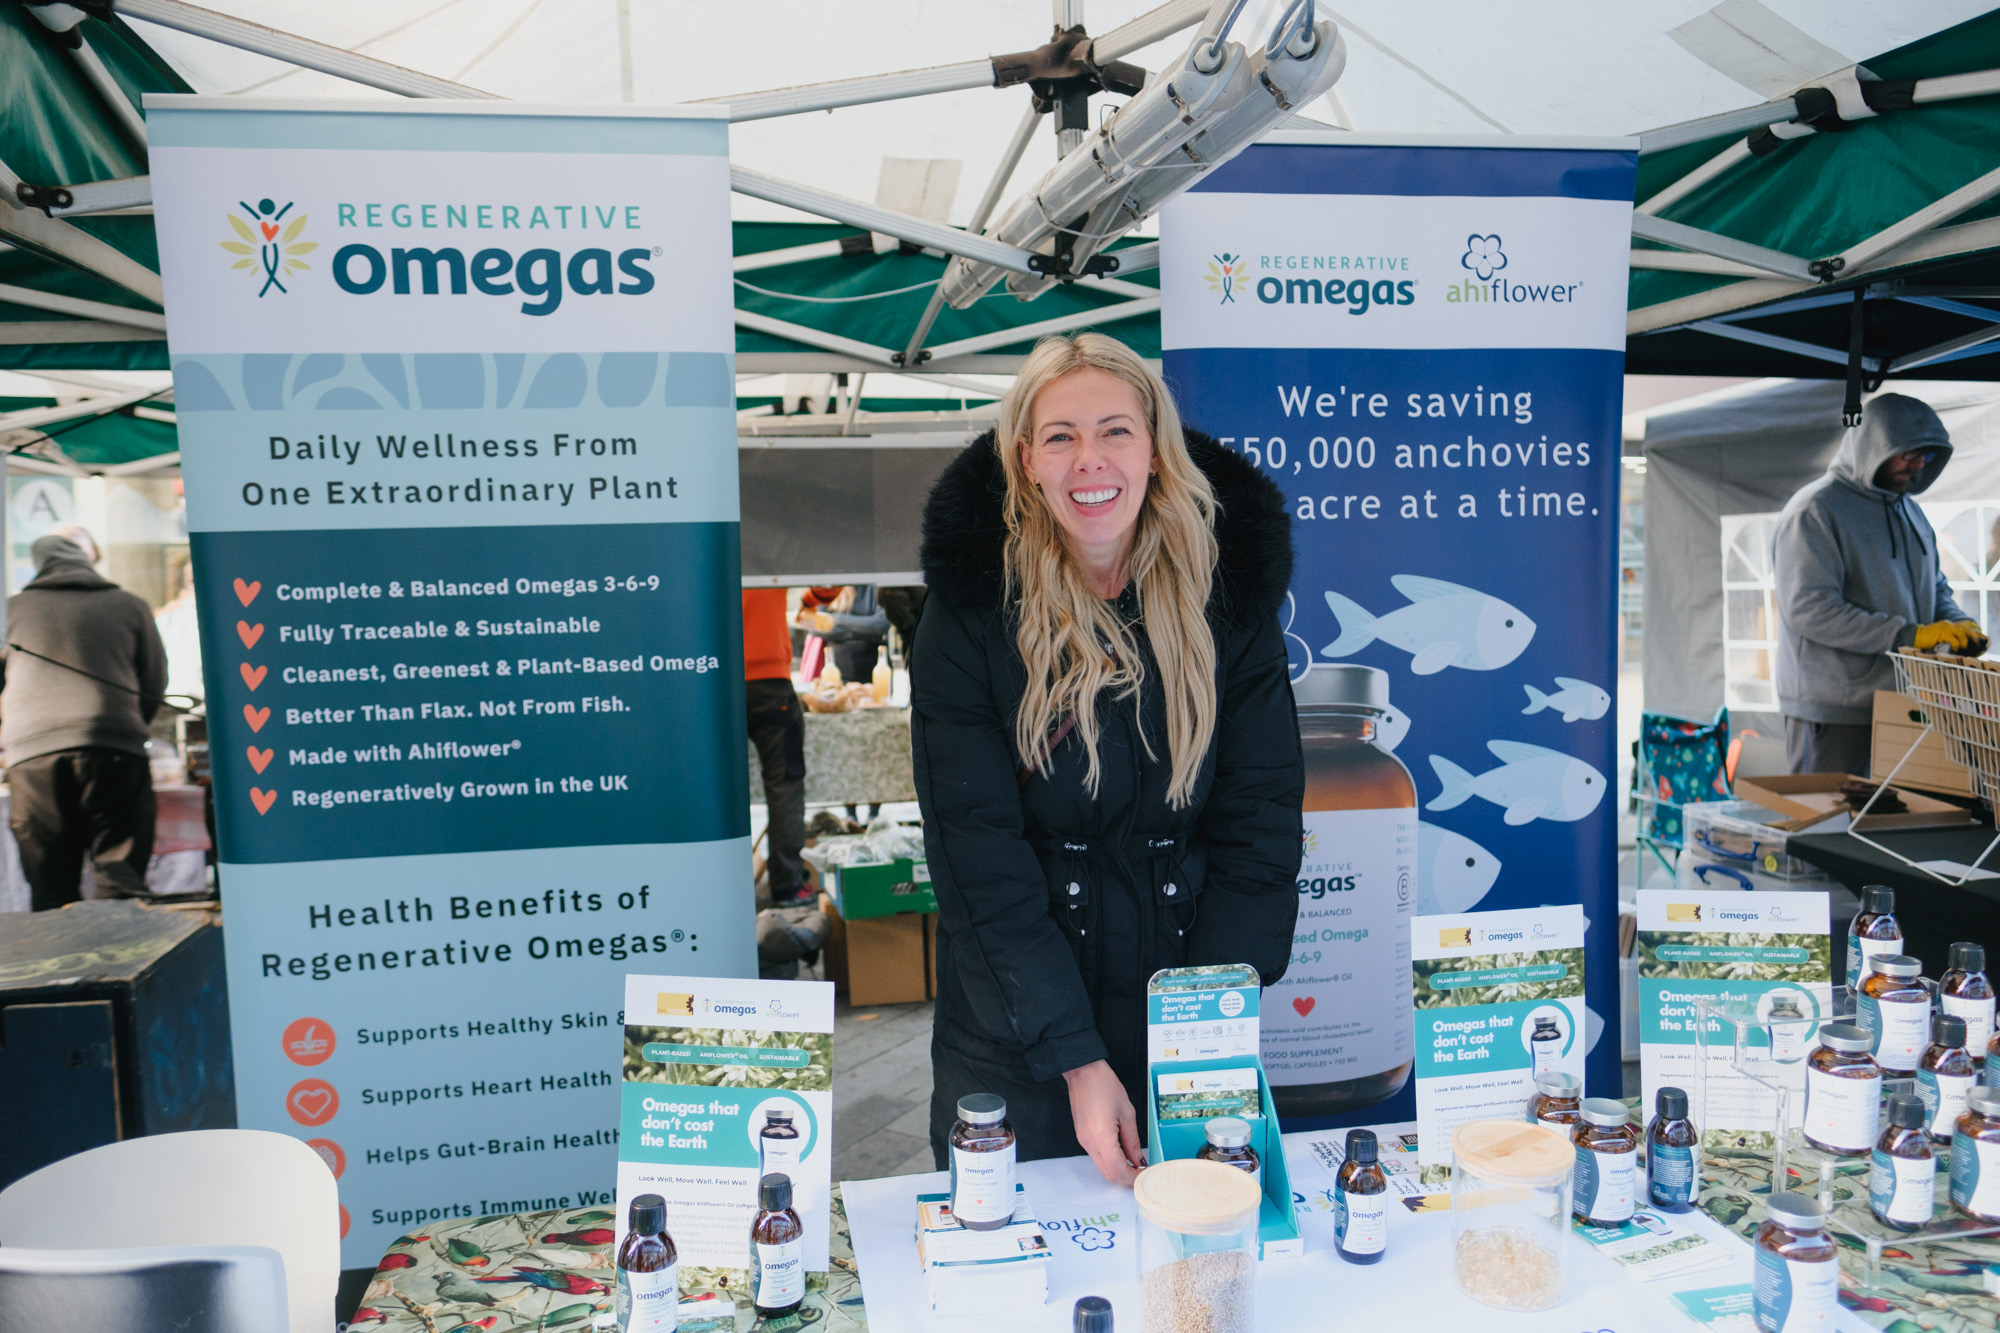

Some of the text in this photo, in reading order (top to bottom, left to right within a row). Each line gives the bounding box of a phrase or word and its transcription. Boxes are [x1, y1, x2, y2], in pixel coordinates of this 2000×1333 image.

[337, 203, 641, 230] REGENERATIVE
[1261, 255, 1410, 271] REGENERATIVE
[1277, 385, 1533, 424] We're saving
[268, 433, 638, 465] Daily Wellness From
[1395, 435, 1591, 469] anchovies
[241, 475, 679, 507] One Extraordinary Plant
[1296, 486, 1599, 521] acre at a time.
[276, 575, 660, 604] Complete & Balanced Omegas 3-6-9
[279, 616, 601, 645] Fully Traceable & Sustainable
[282, 654, 719, 685] Cleanest, Greenest & Plant-Based Omega
[286, 695, 631, 726] Better Than Flax. Not From Fish.
[289, 748, 348, 767] Made
[353, 744, 402, 763] with
[292, 774, 629, 808] Regeneratively Grown in the UK
[309, 885, 652, 929] Health Benefits of
[1308, 908, 1352, 918] BALANCED
[1720, 912, 1759, 922] omegas
[1321, 929, 1369, 942] Omega
[1488, 931, 1523, 941] omegas
[261, 940, 512, 981] Regenerative
[1278, 978, 1294, 986] with
[1437, 976, 1472, 984] PLANT-BASED
[1527, 969, 1559, 977] SUSTAINABLE
[1162, 993, 1215, 1004] Omegas that
[714, 1005, 757, 1017] omegas
[1162, 1005, 1184, 1013] don't
[1162, 1012, 1198, 1022] the Earth
[1659, 1004, 1696, 1016] don't
[357, 1021, 460, 1048] Supports
[467, 1014, 554, 1041] Healthy
[561, 1011, 608, 1030] Skin
[1432, 1014, 1514, 1033] Omegas that
[1660, 1018, 1682, 1030] the
[1433, 1032, 1495, 1049] don't cost
[1264, 1046, 1343, 1059] FOOD SUPPLEMENT
[1433, 1046, 1490, 1063] the Earth
[362, 1070, 612, 1108] Supports Heart Health
[642, 1098, 740, 1116] Omegas that
[641, 1114, 714, 1132] don't cost
[366, 1128, 620, 1169] Helps Gut-Brain Health
[641, 1133, 708, 1150] the Earth
[964, 1167, 994, 1176] omegas
[372, 1195, 570, 1227] Supports Immune
[1352, 1210, 1383, 1221] omegas
[764, 1257, 799, 1270] omegas
[636, 1286, 673, 1300] omegas
